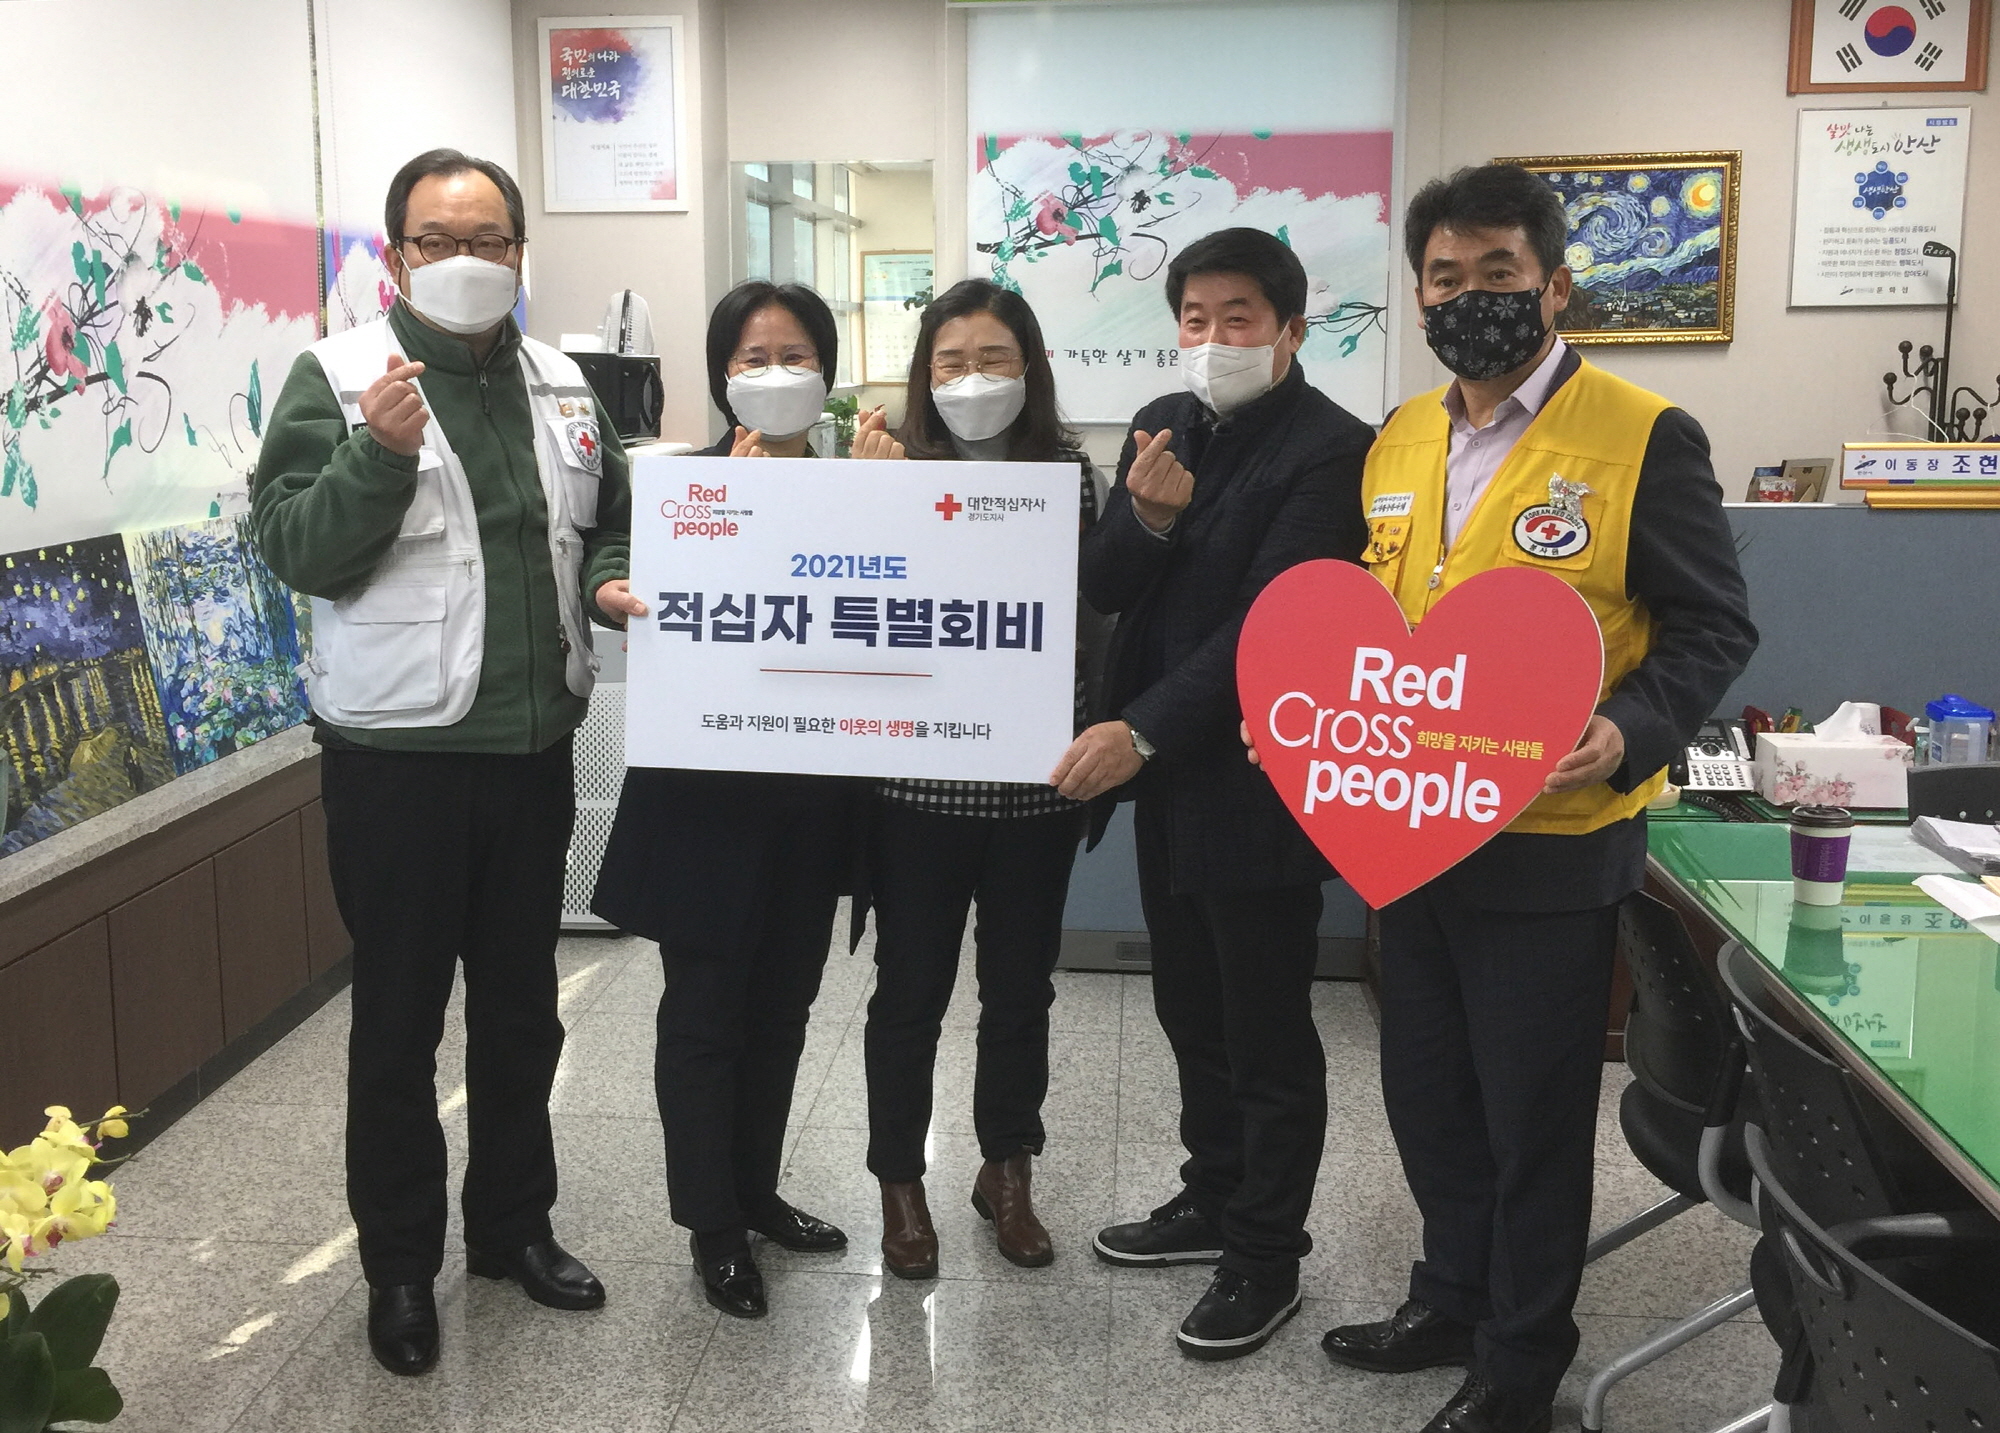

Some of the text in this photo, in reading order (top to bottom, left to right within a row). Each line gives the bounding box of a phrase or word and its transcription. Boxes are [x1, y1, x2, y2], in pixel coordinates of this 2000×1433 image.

[559, 47, 620, 65] 국민의 나라
[561, 67, 595, 80] 정의로운
[561, 80, 621, 100] 대한민국
[1894, 134, 1941, 155] 안산
[1063, 348, 1108, 366] 가득한
[1116, 348, 1146, 366] 살기
[1156, 349, 1179, 368] 좋은
[688, 483, 727, 503] Red
[661, 499, 712, 519] Cross
[967, 496, 1046, 512] 대한적십자사
[967, 513, 1004, 522] 경기도지사
[1523, 508, 1551, 521] KOREAN
[1551, 509, 1566, 518] RED
[673, 517, 739, 541] people
[791, 553, 907, 580] 2021년도
[656, 591, 1044, 652] 적십자 특별회비
[1349, 646, 1468, 711] Red
[701, 713, 992, 740] 도움과 지원이 필요한 이웃의 생명을 지킵니다
[1268, 691, 1414, 760] Cross
[1416, 730, 1545, 761] 희망을 지키는 사람들
[1303, 759, 1501, 830] people
